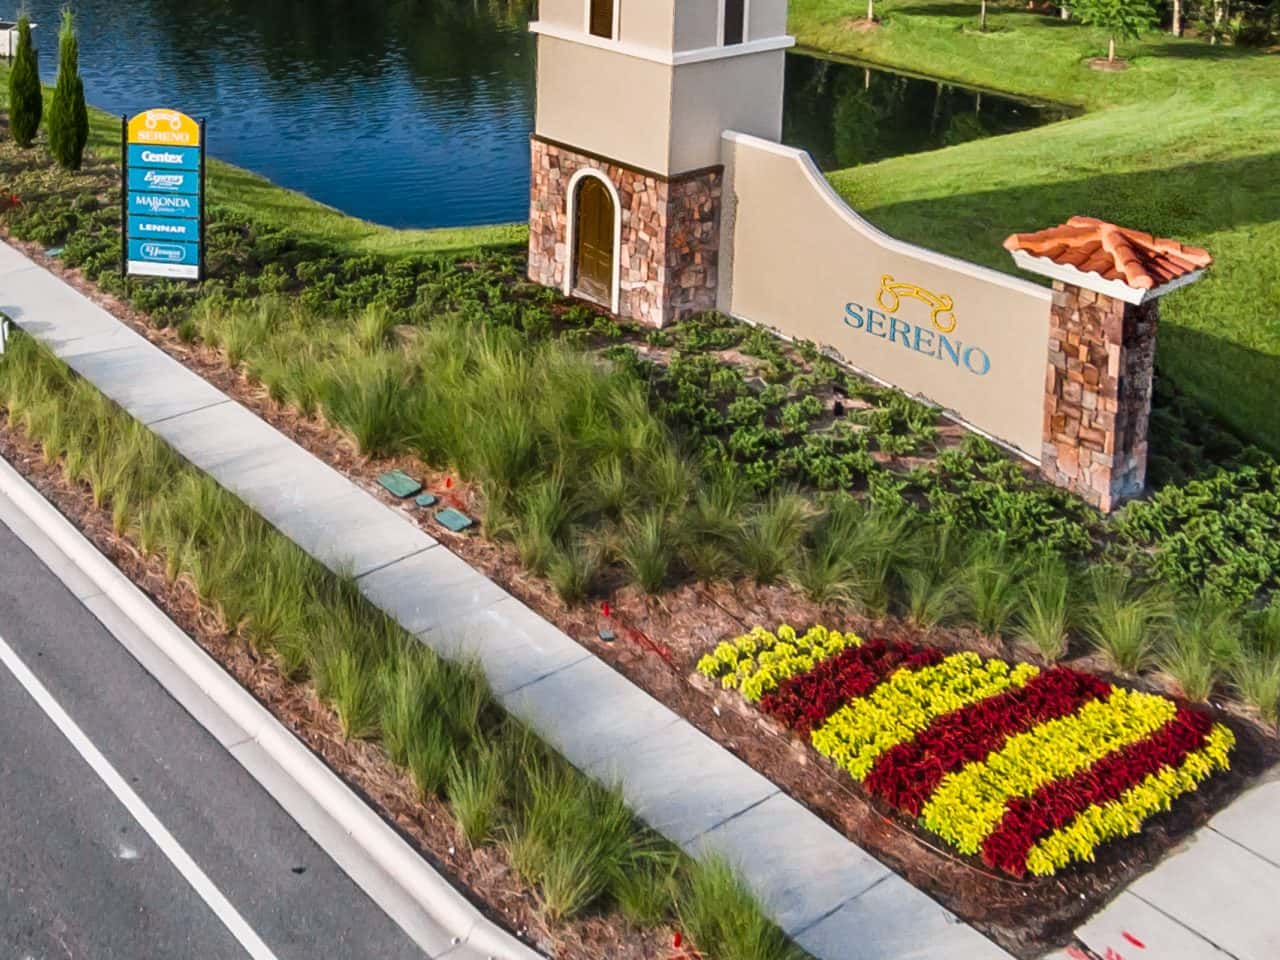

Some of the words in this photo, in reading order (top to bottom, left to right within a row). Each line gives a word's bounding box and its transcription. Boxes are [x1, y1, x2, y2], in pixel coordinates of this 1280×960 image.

[137, 129, 190, 143] SERENO
[141, 150, 184, 164] Centex
[136, 195, 190, 209] MARONDA
[139, 223, 186, 234] LENNAR
[843, 302, 991, 376] SERENO
